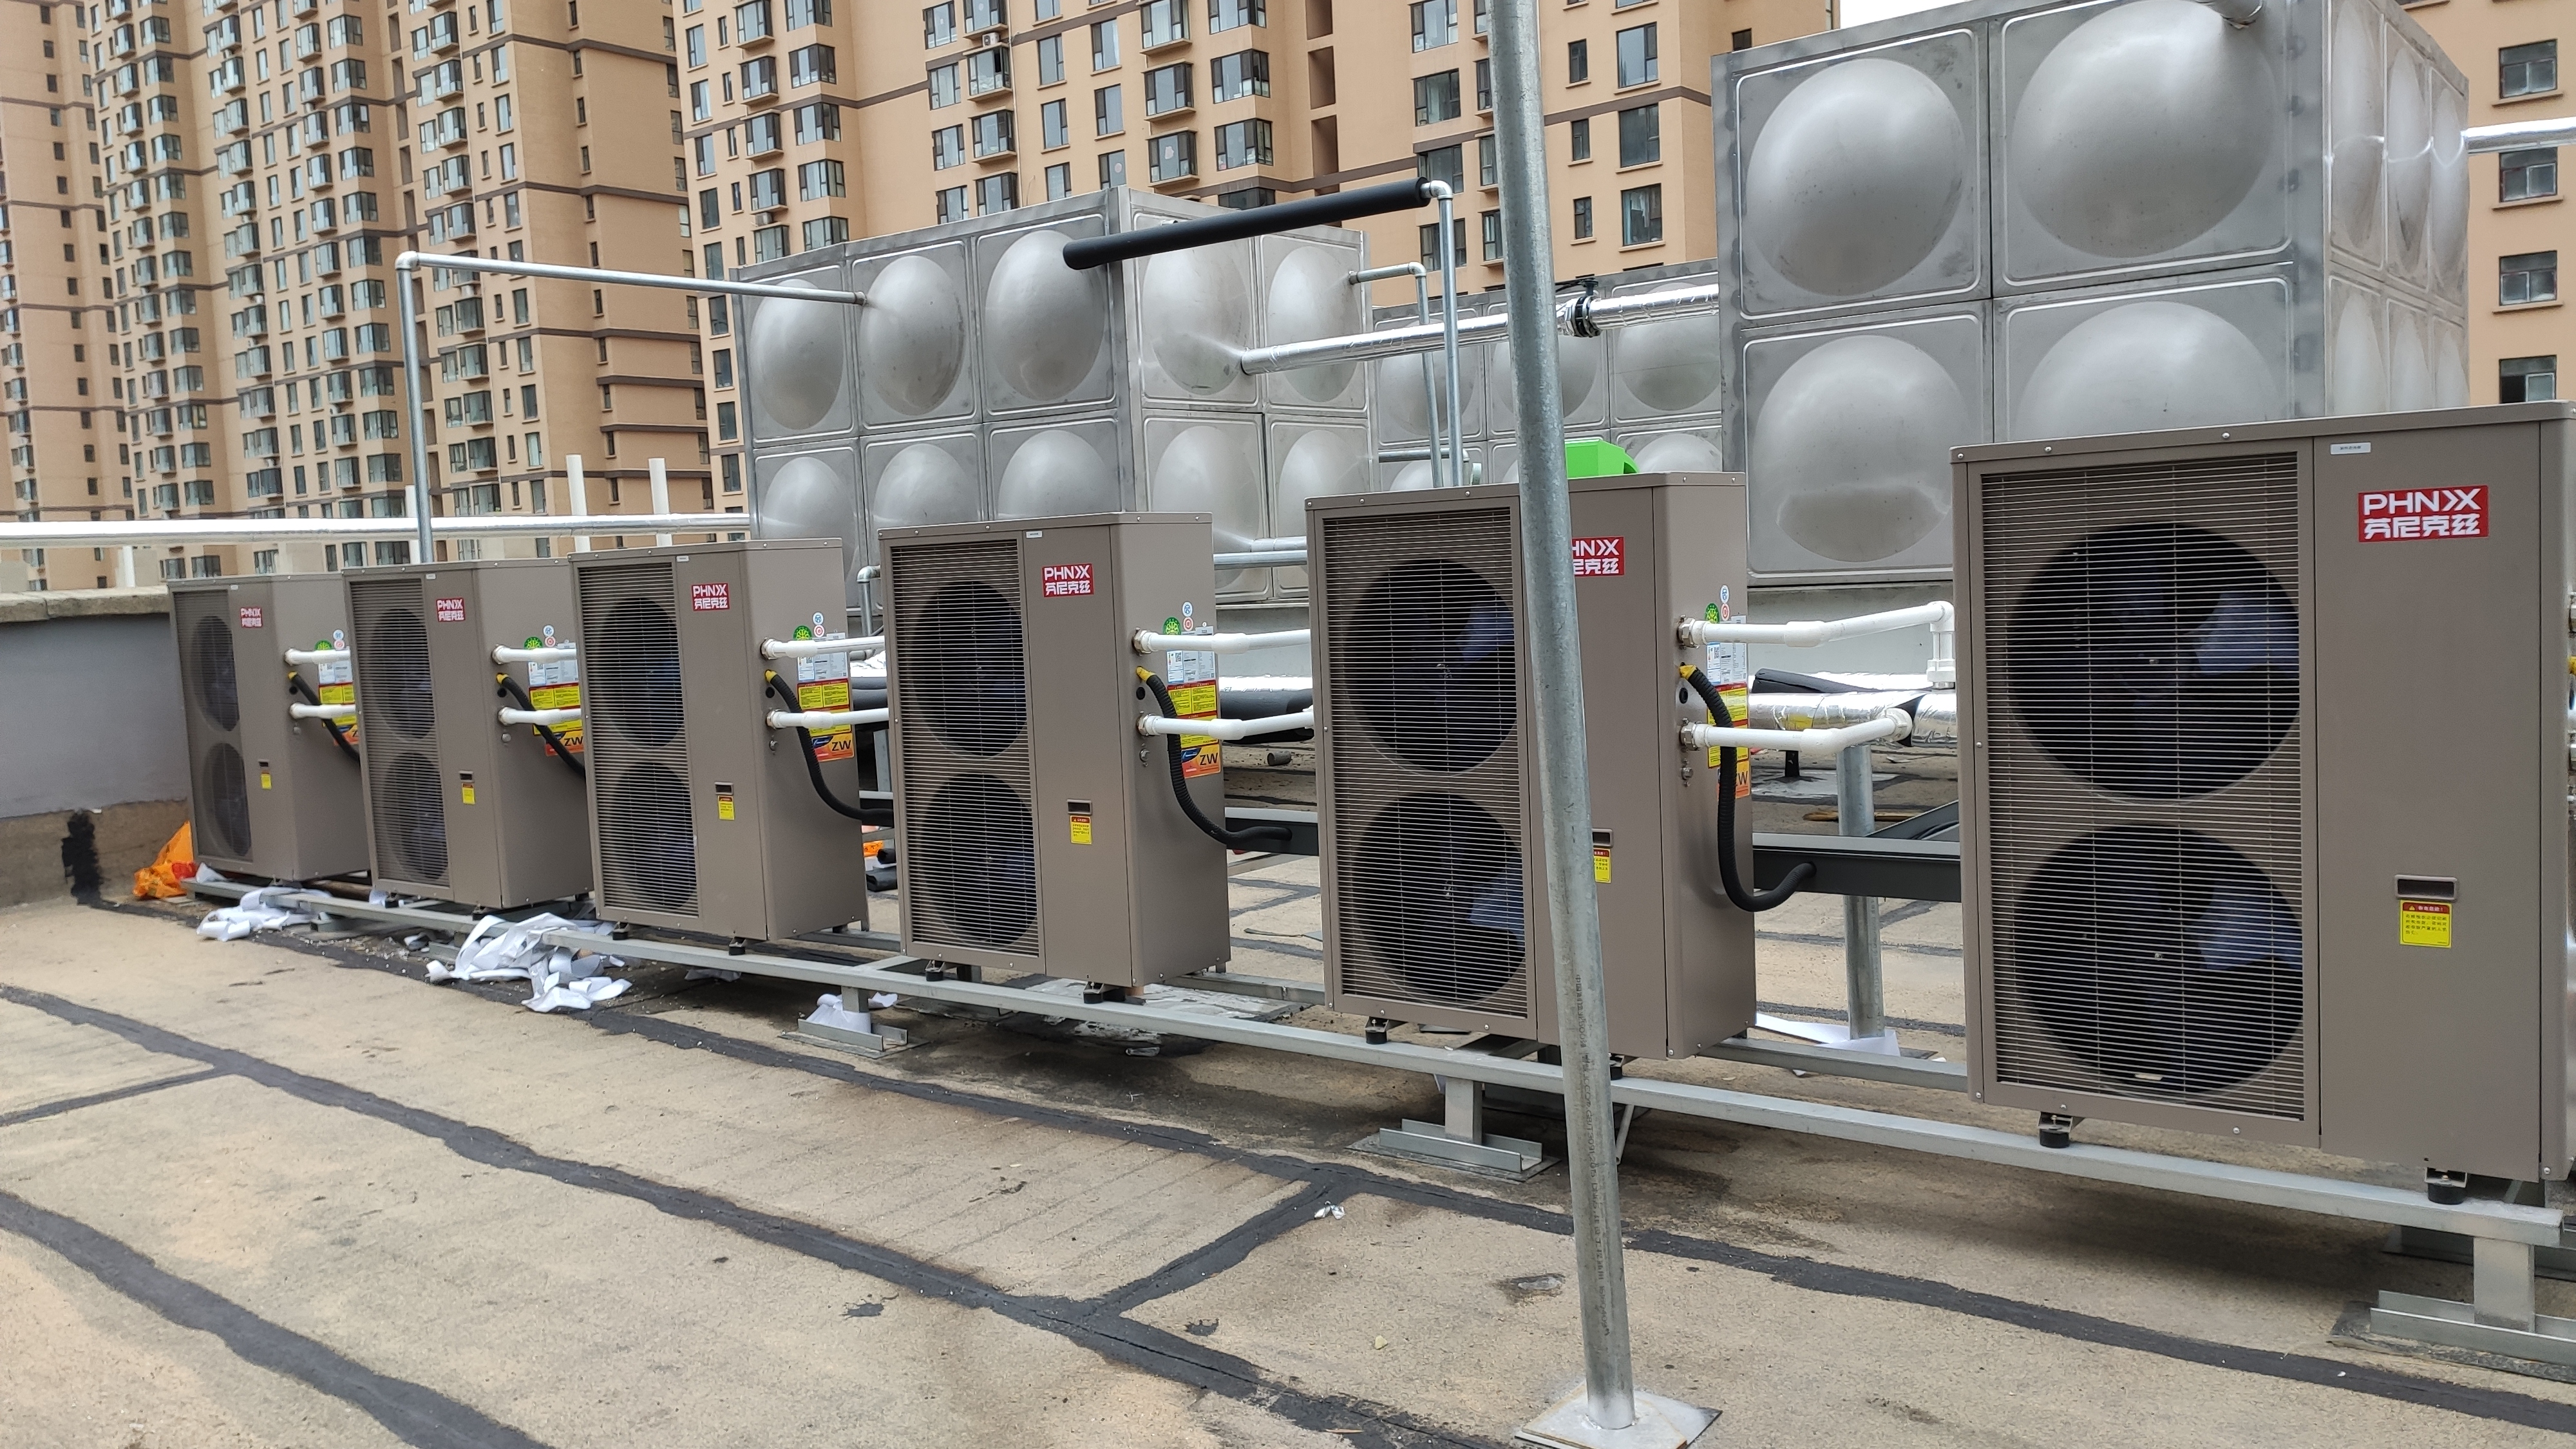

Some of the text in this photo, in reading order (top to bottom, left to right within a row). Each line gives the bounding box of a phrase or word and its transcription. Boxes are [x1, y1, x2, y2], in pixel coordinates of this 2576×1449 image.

[1573, 558, 1619, 575] 尼克兹
[564, 736, 583, 746] ZW
[832, 740, 851, 752] ZW
[1199, 752, 1218, 766] ZW
